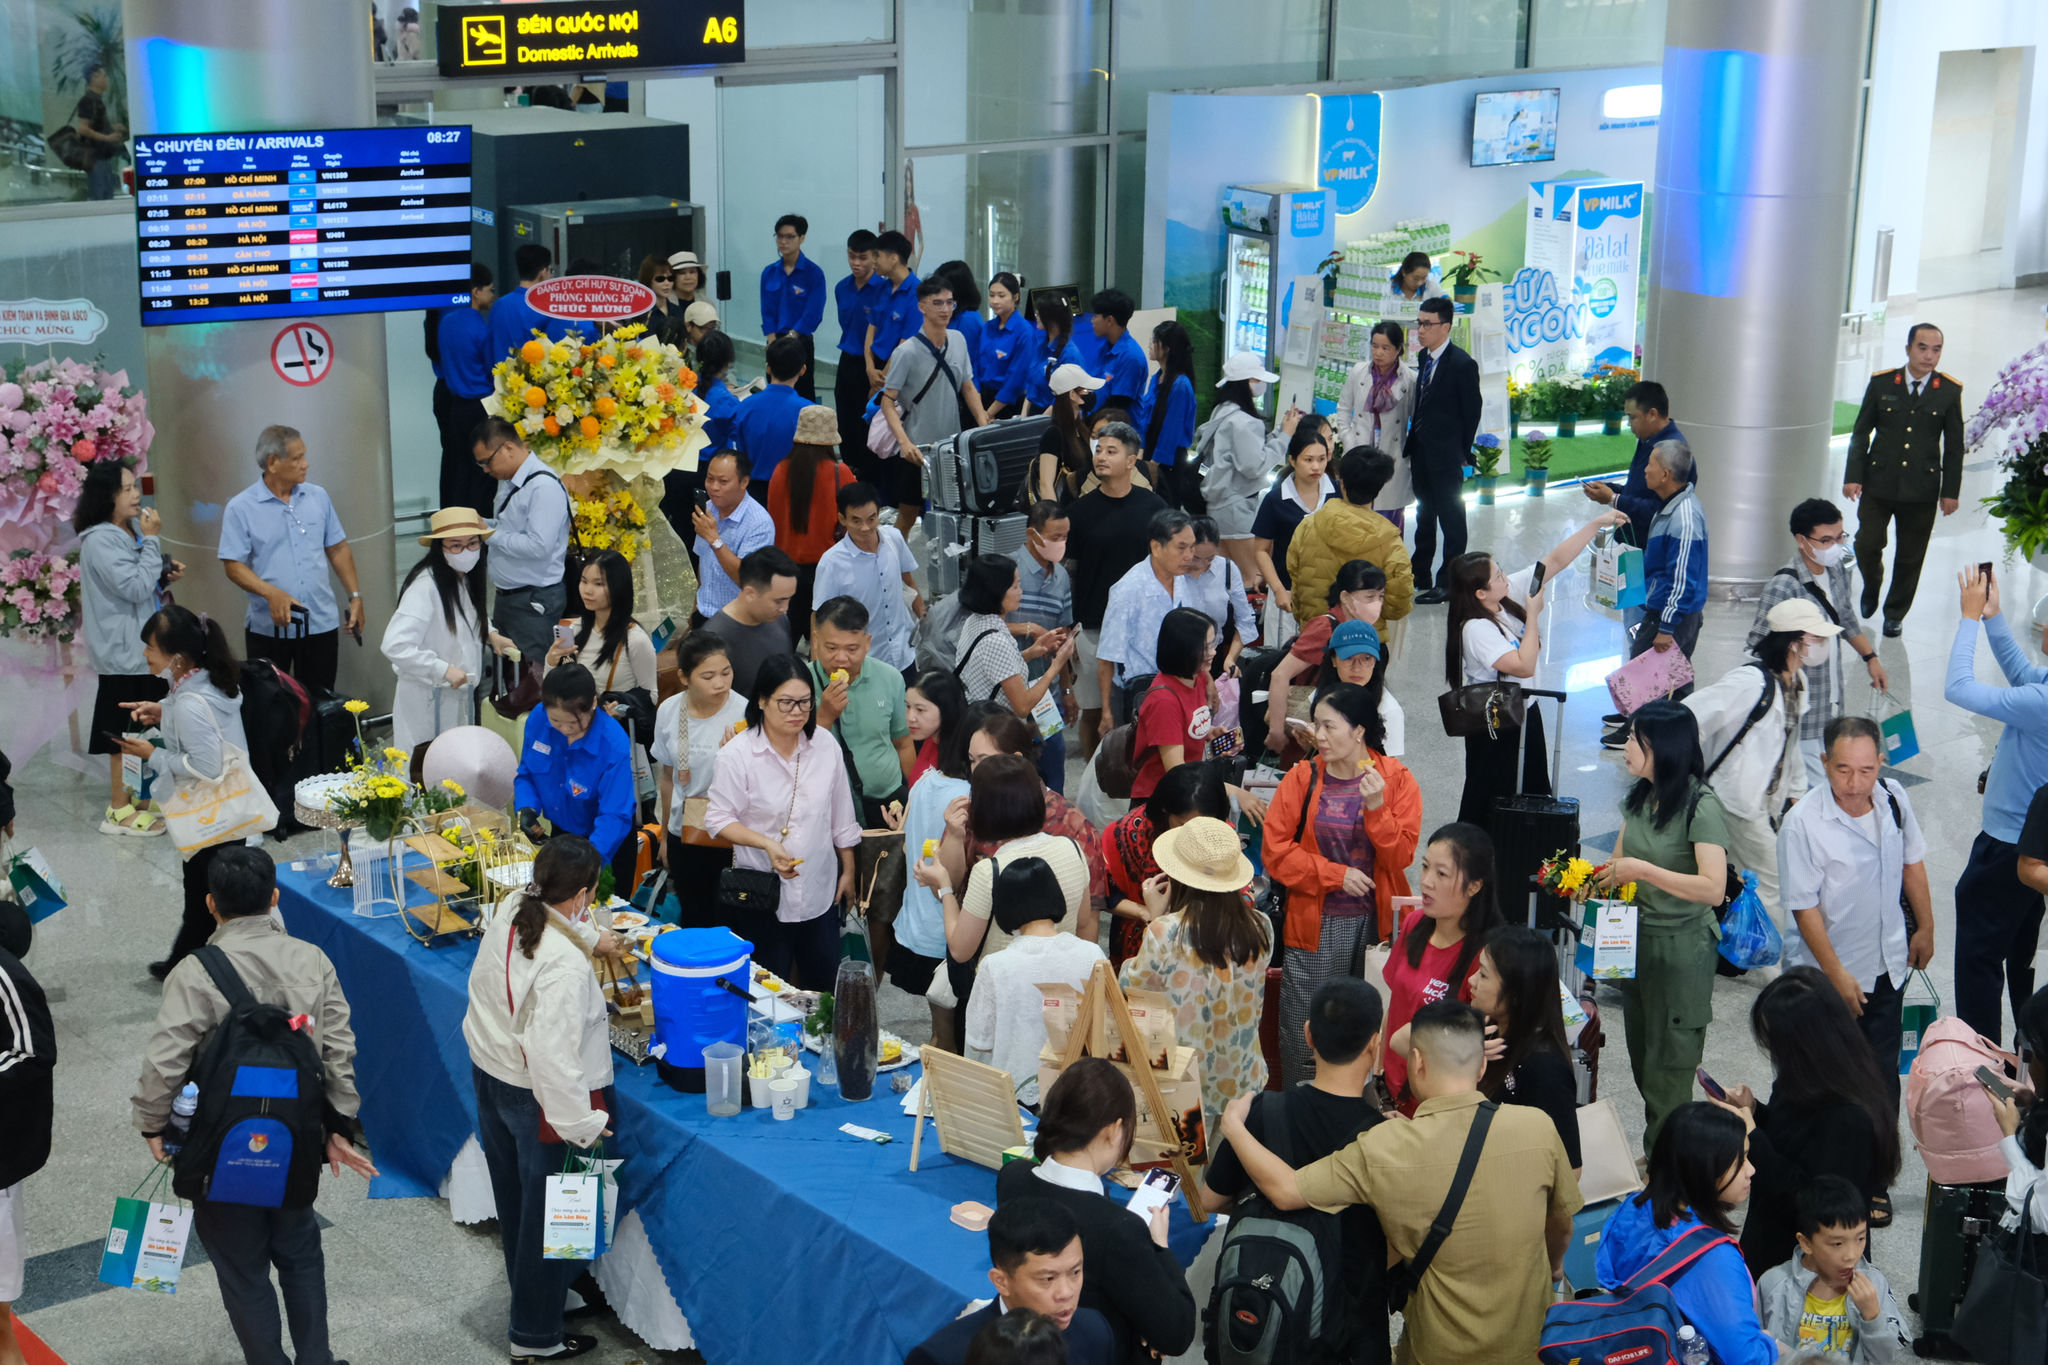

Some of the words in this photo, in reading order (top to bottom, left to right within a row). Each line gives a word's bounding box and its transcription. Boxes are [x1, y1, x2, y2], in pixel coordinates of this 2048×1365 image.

[517, 14, 552, 34] ĐẾN
[555, 11, 606, 34] QUỐC
[608, 10, 638, 34] NỘI
[703, 16, 738, 44] A6
[517, 44, 584, 63] Domestic
[586, 42, 638, 59] Arrivals
[427, 131, 460, 144] 08:27
[248, 138, 254, 150] /
[256, 136, 324, 150] ARRIVALS
[400, 169, 424, 177] Arrived
[1324, 166, 1371, 182] VPMILK
[146, 178, 168, 187] 07:00
[184, 178, 206, 186] 07:00
[224, 175, 237, 184] HỒ
[238, 174, 253, 184] CHÍ
[254, 175, 277, 183] MINH
[400, 198, 424, 206] Arrived
[1584, 193, 1635, 212] VPMILK
[147, 210, 169, 218] 07:55
[185, 208, 206, 216] 07:55
[226, 206, 238, 214] HỒ
[239, 205, 253, 214] CHÍ
[255, 205, 278, 213] MINH
[186, 238, 208, 246] 08:20
[238, 235, 250, 244] HÀ
[252, 234, 267, 244] NỘI
[148, 240, 171, 248] 08:20
[227, 265, 240, 274] HỒ
[241, 264, 255, 274] CHÍ
[257, 265, 279, 273] MINH
[150, 270, 171, 278] 11:15
[591, 280, 608, 289] HUY
[189, 298, 209, 306] 13:25
[240, 294, 251, 303] HÀ
[253, 294, 268, 303] NỘI
[151, 300, 172, 308] 13:25
